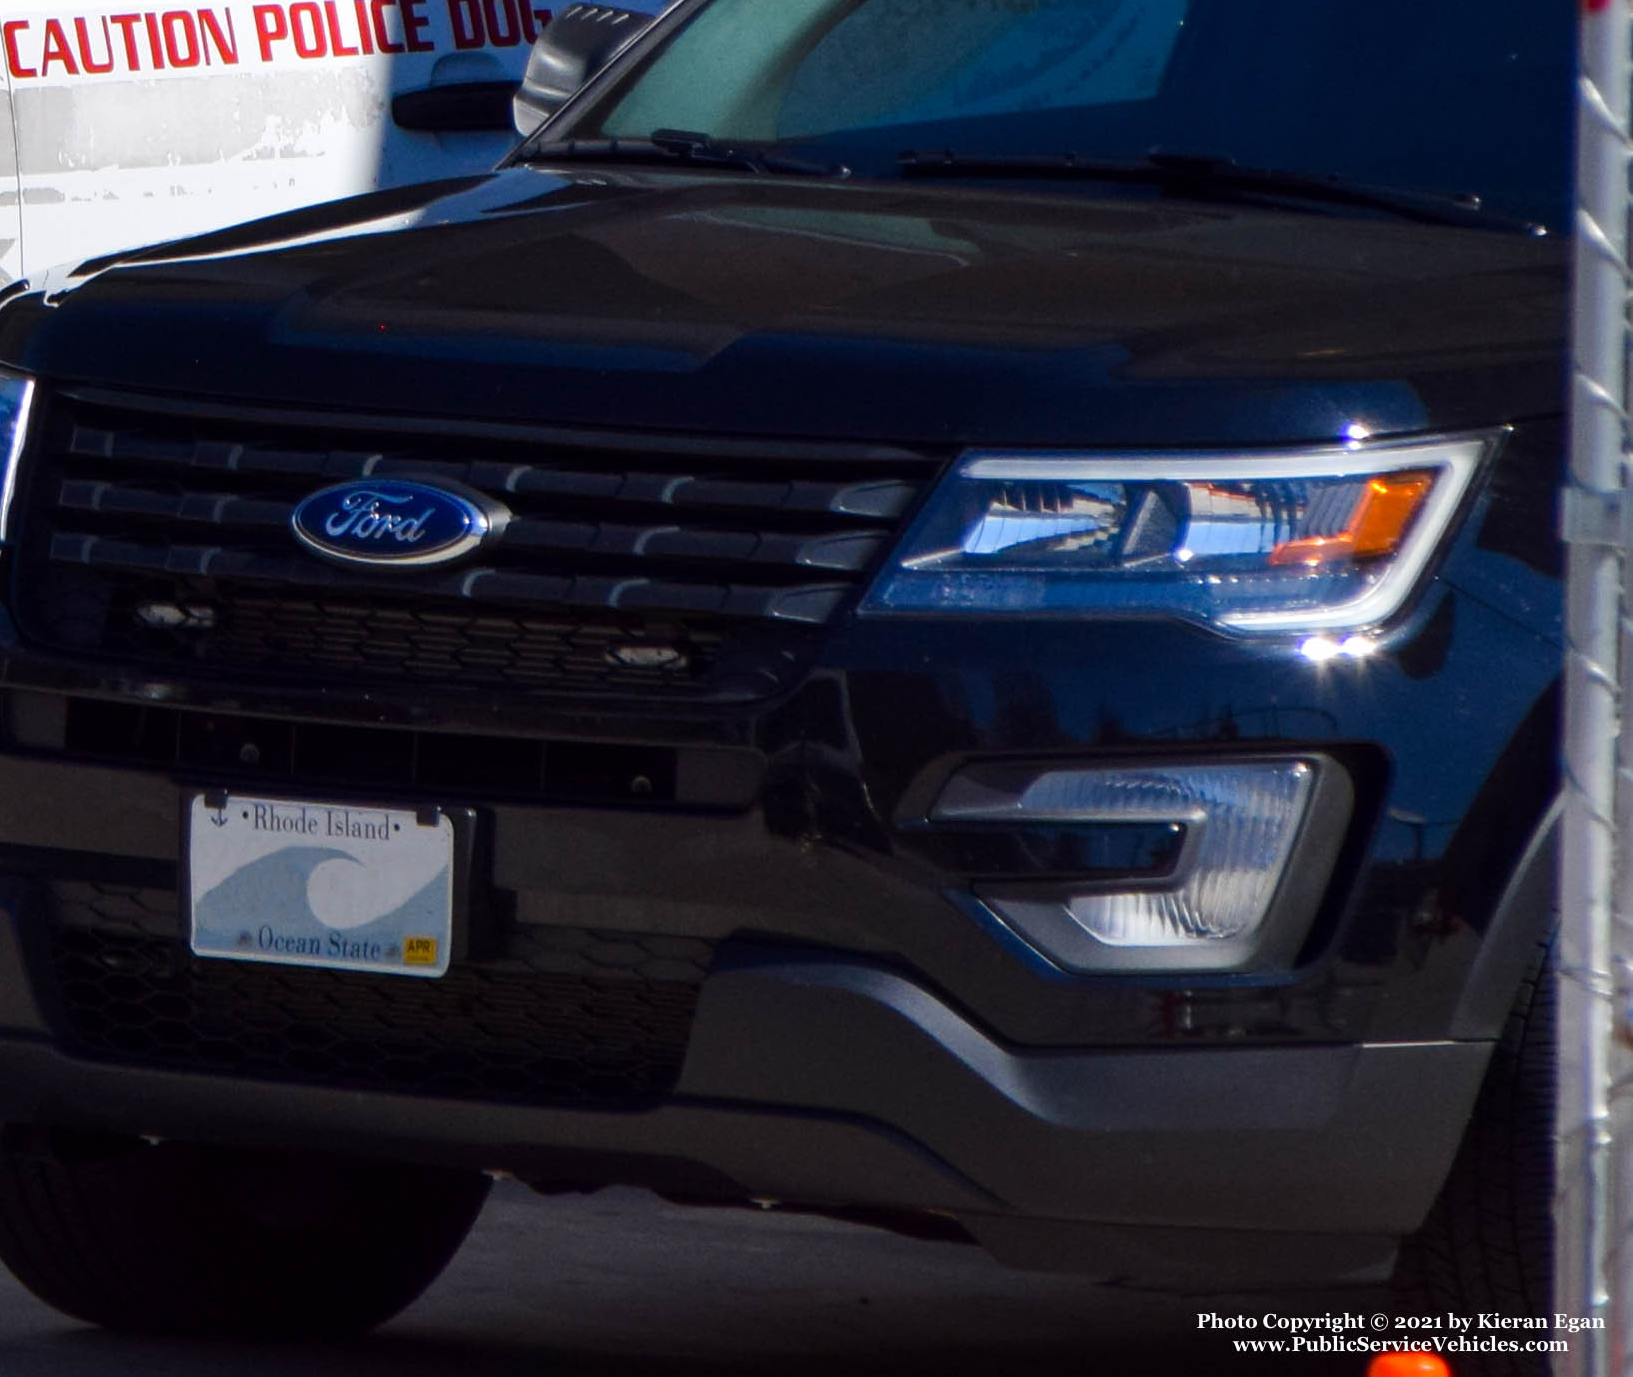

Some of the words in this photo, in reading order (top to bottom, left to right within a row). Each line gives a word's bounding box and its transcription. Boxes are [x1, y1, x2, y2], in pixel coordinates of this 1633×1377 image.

[3, 9, 238, 78] CAUTION
[325, 490, 427, 544] Ford
[252, 804, 318, 836] Rhode
[324, 809, 391, 841] Island
[257, 926, 320, 956] Ocean
[327, 932, 380, 960] State
[408, 938, 431, 953] APR
